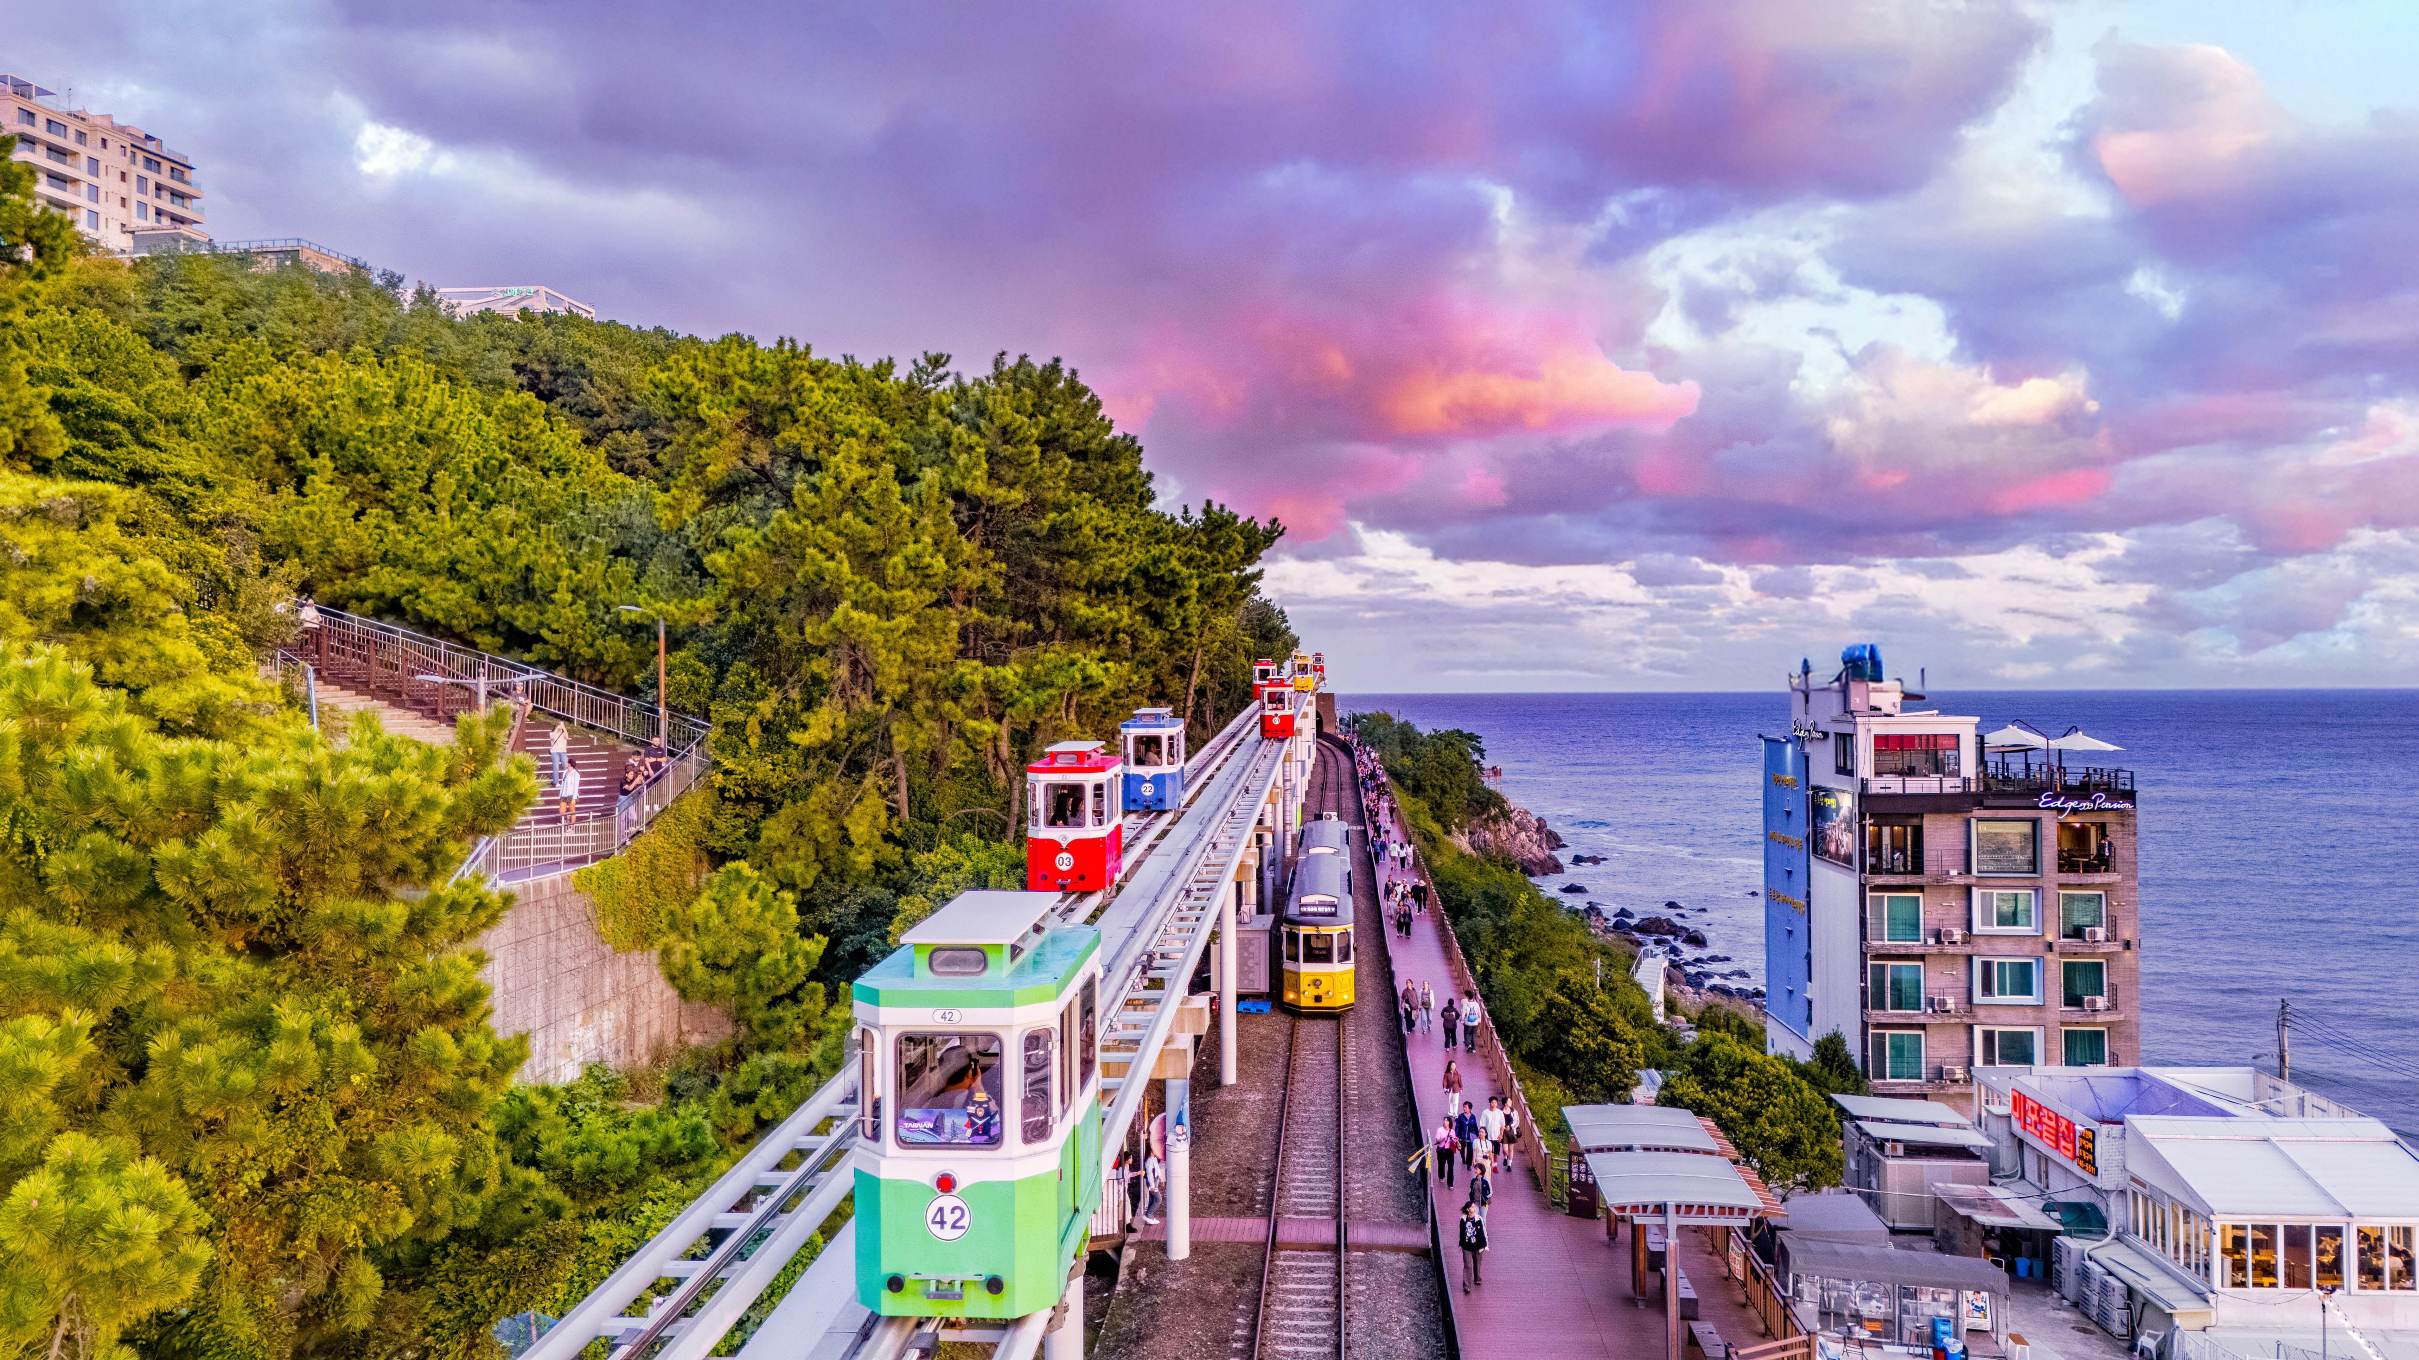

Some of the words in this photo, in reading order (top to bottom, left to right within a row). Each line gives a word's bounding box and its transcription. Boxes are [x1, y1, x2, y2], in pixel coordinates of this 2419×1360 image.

[2038, 791, 2079, 819] Edge
[2091, 792, 2134, 810] Pension
[1058, 857, 1071, 867] 03
[941, 1011, 954, 1022] 42
[2011, 1088, 2076, 1160] 미포끝집
[931, 1206, 966, 1230] 42
